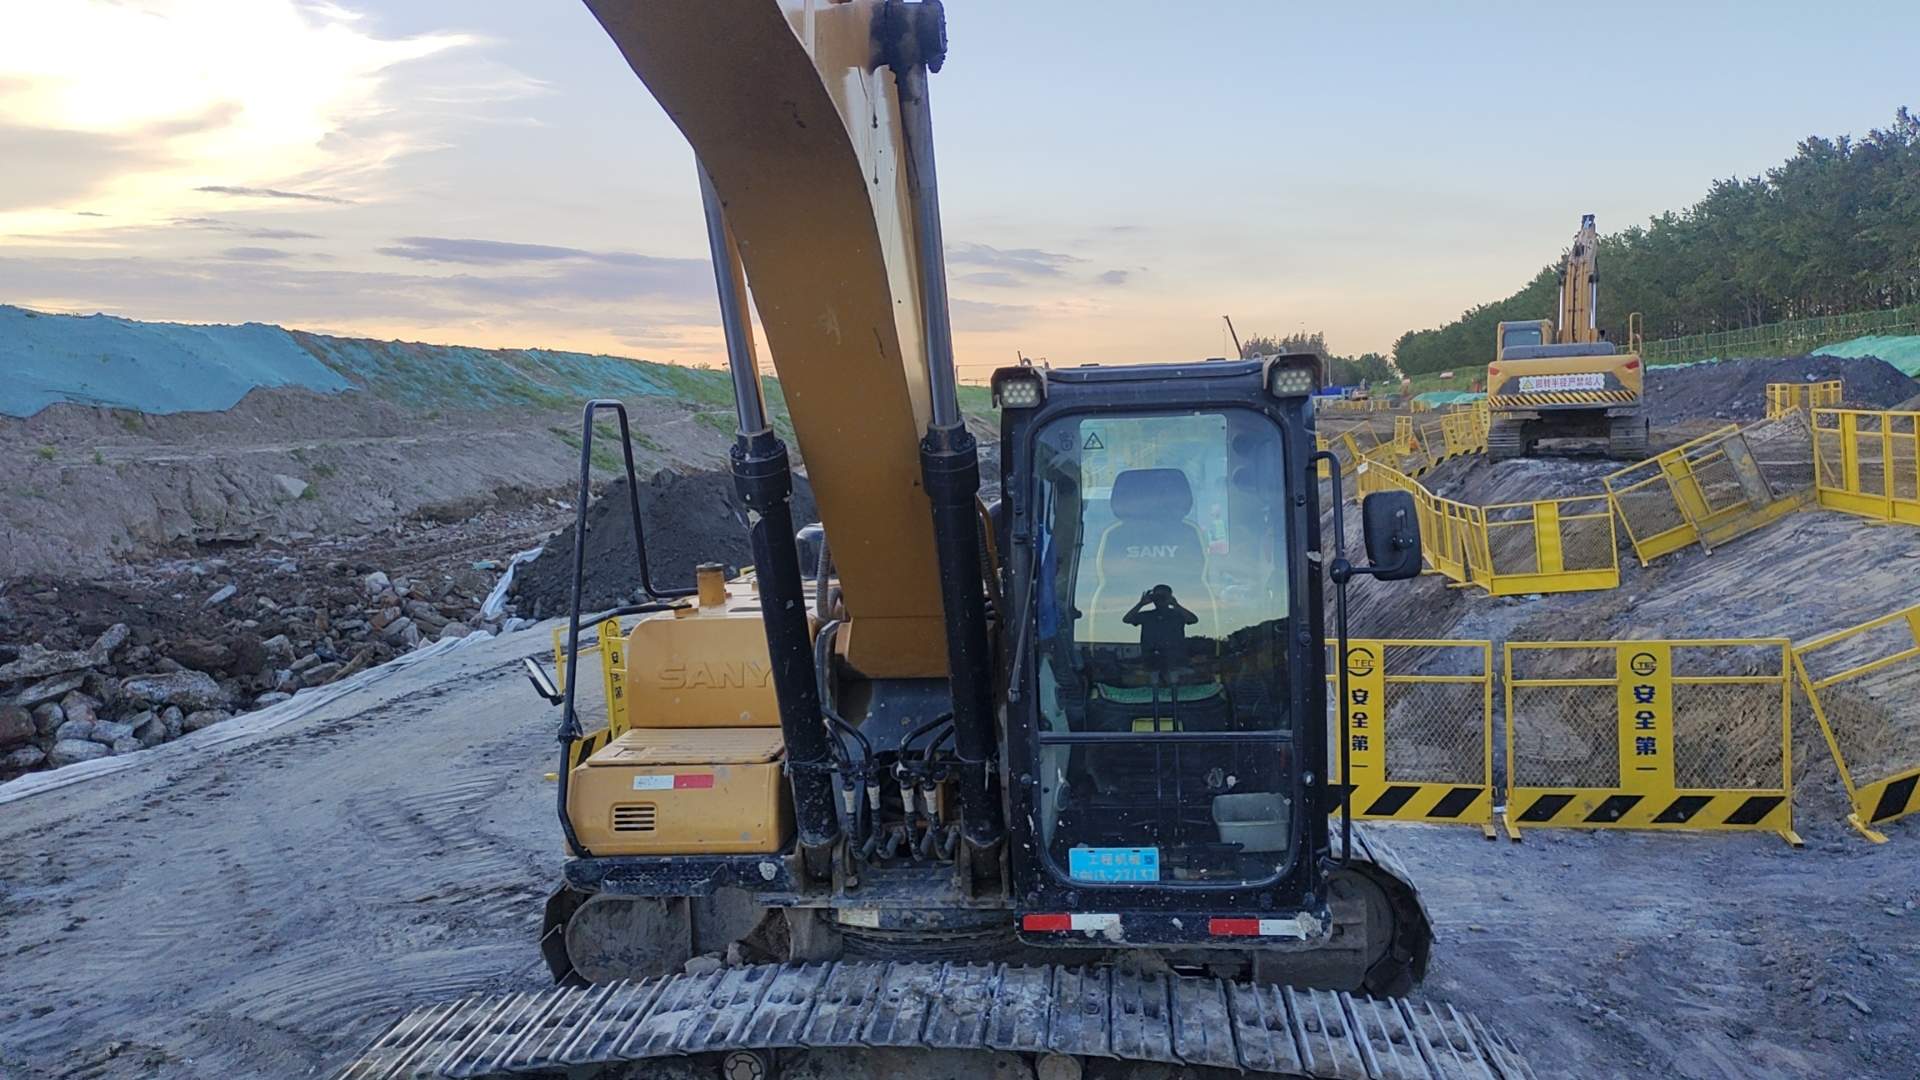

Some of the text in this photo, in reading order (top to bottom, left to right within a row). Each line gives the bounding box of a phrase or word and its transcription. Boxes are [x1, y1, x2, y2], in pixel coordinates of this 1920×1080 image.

[1126, 545, 1179, 559] SANY
[658, 661, 773, 690] SANY
[1351, 687, 1370, 769] 安全第一
[1633, 684, 1658, 771] 安全第一
